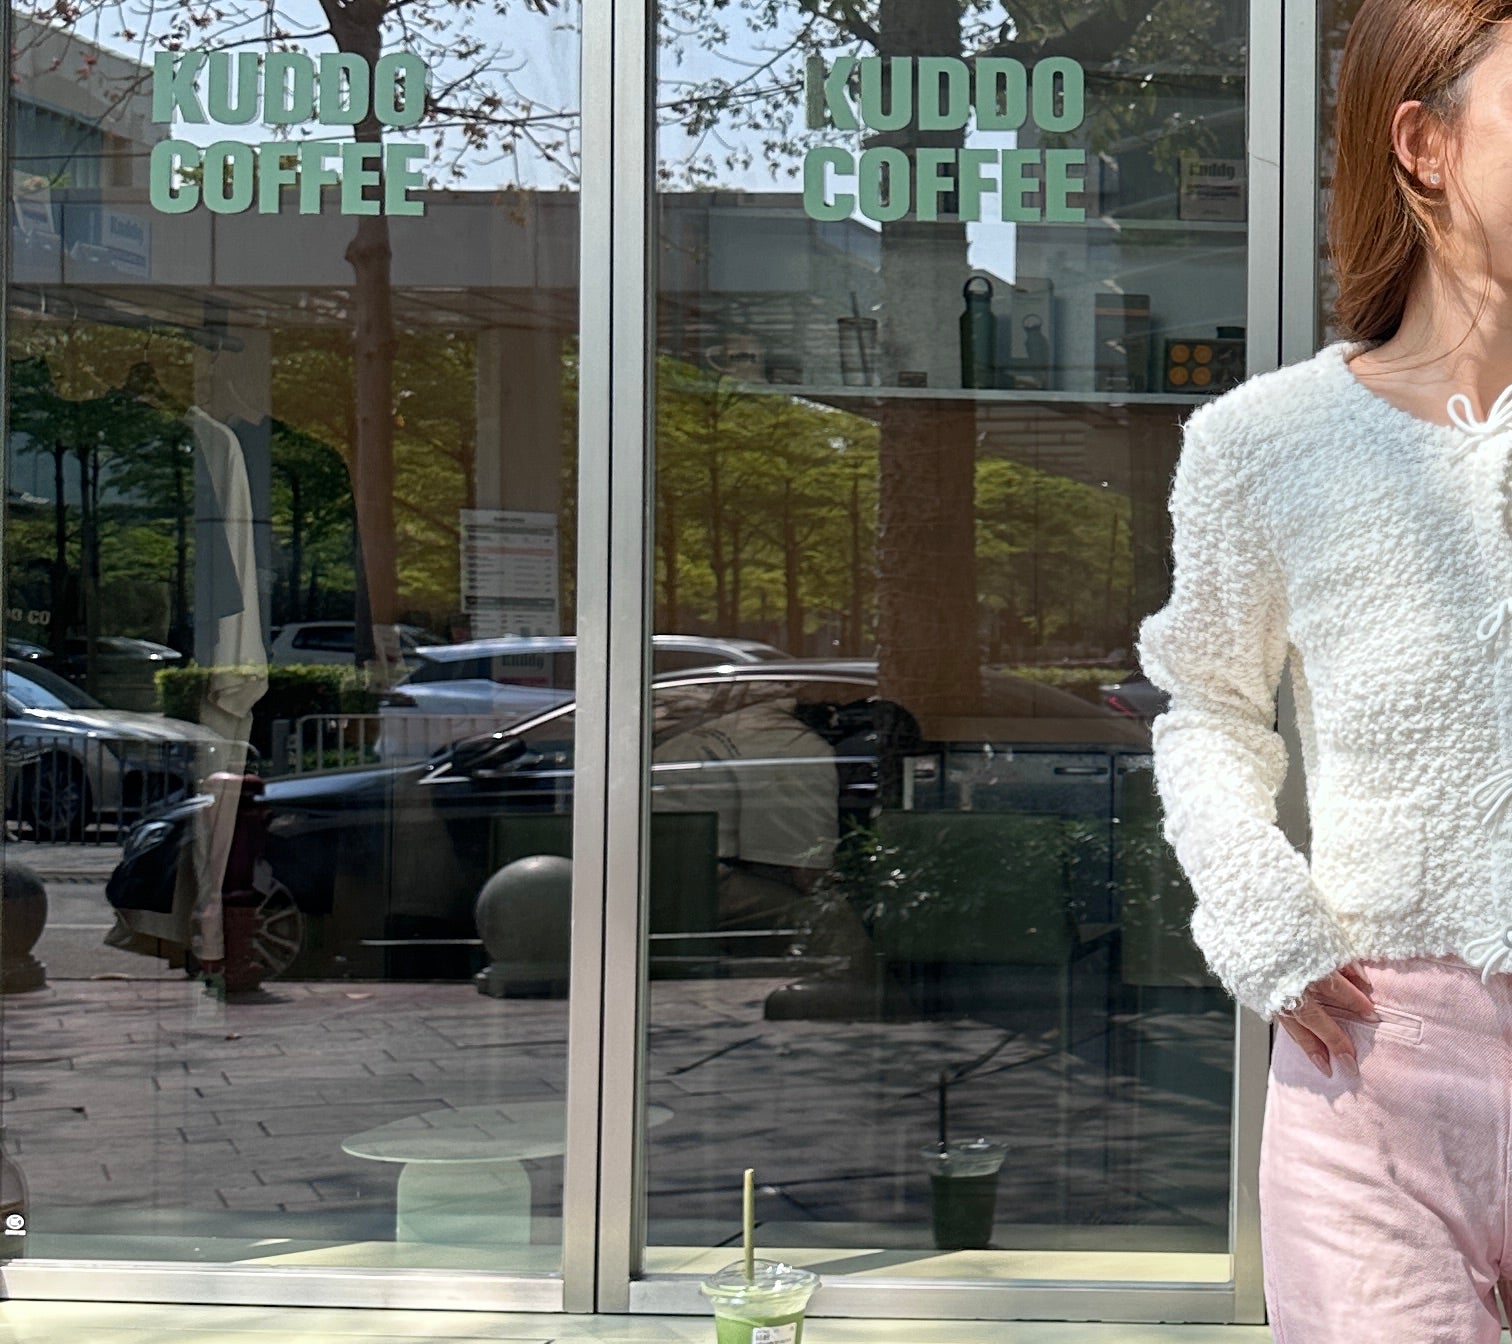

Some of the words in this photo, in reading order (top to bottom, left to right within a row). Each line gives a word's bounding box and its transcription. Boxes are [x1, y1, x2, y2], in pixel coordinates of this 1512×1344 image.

[152, 50, 428, 127] KUDDO
[805, 55, 1085, 133] KUDDO
[150, 139, 427, 215] COFFEE
[803, 146, 1086, 223] COFFEE
